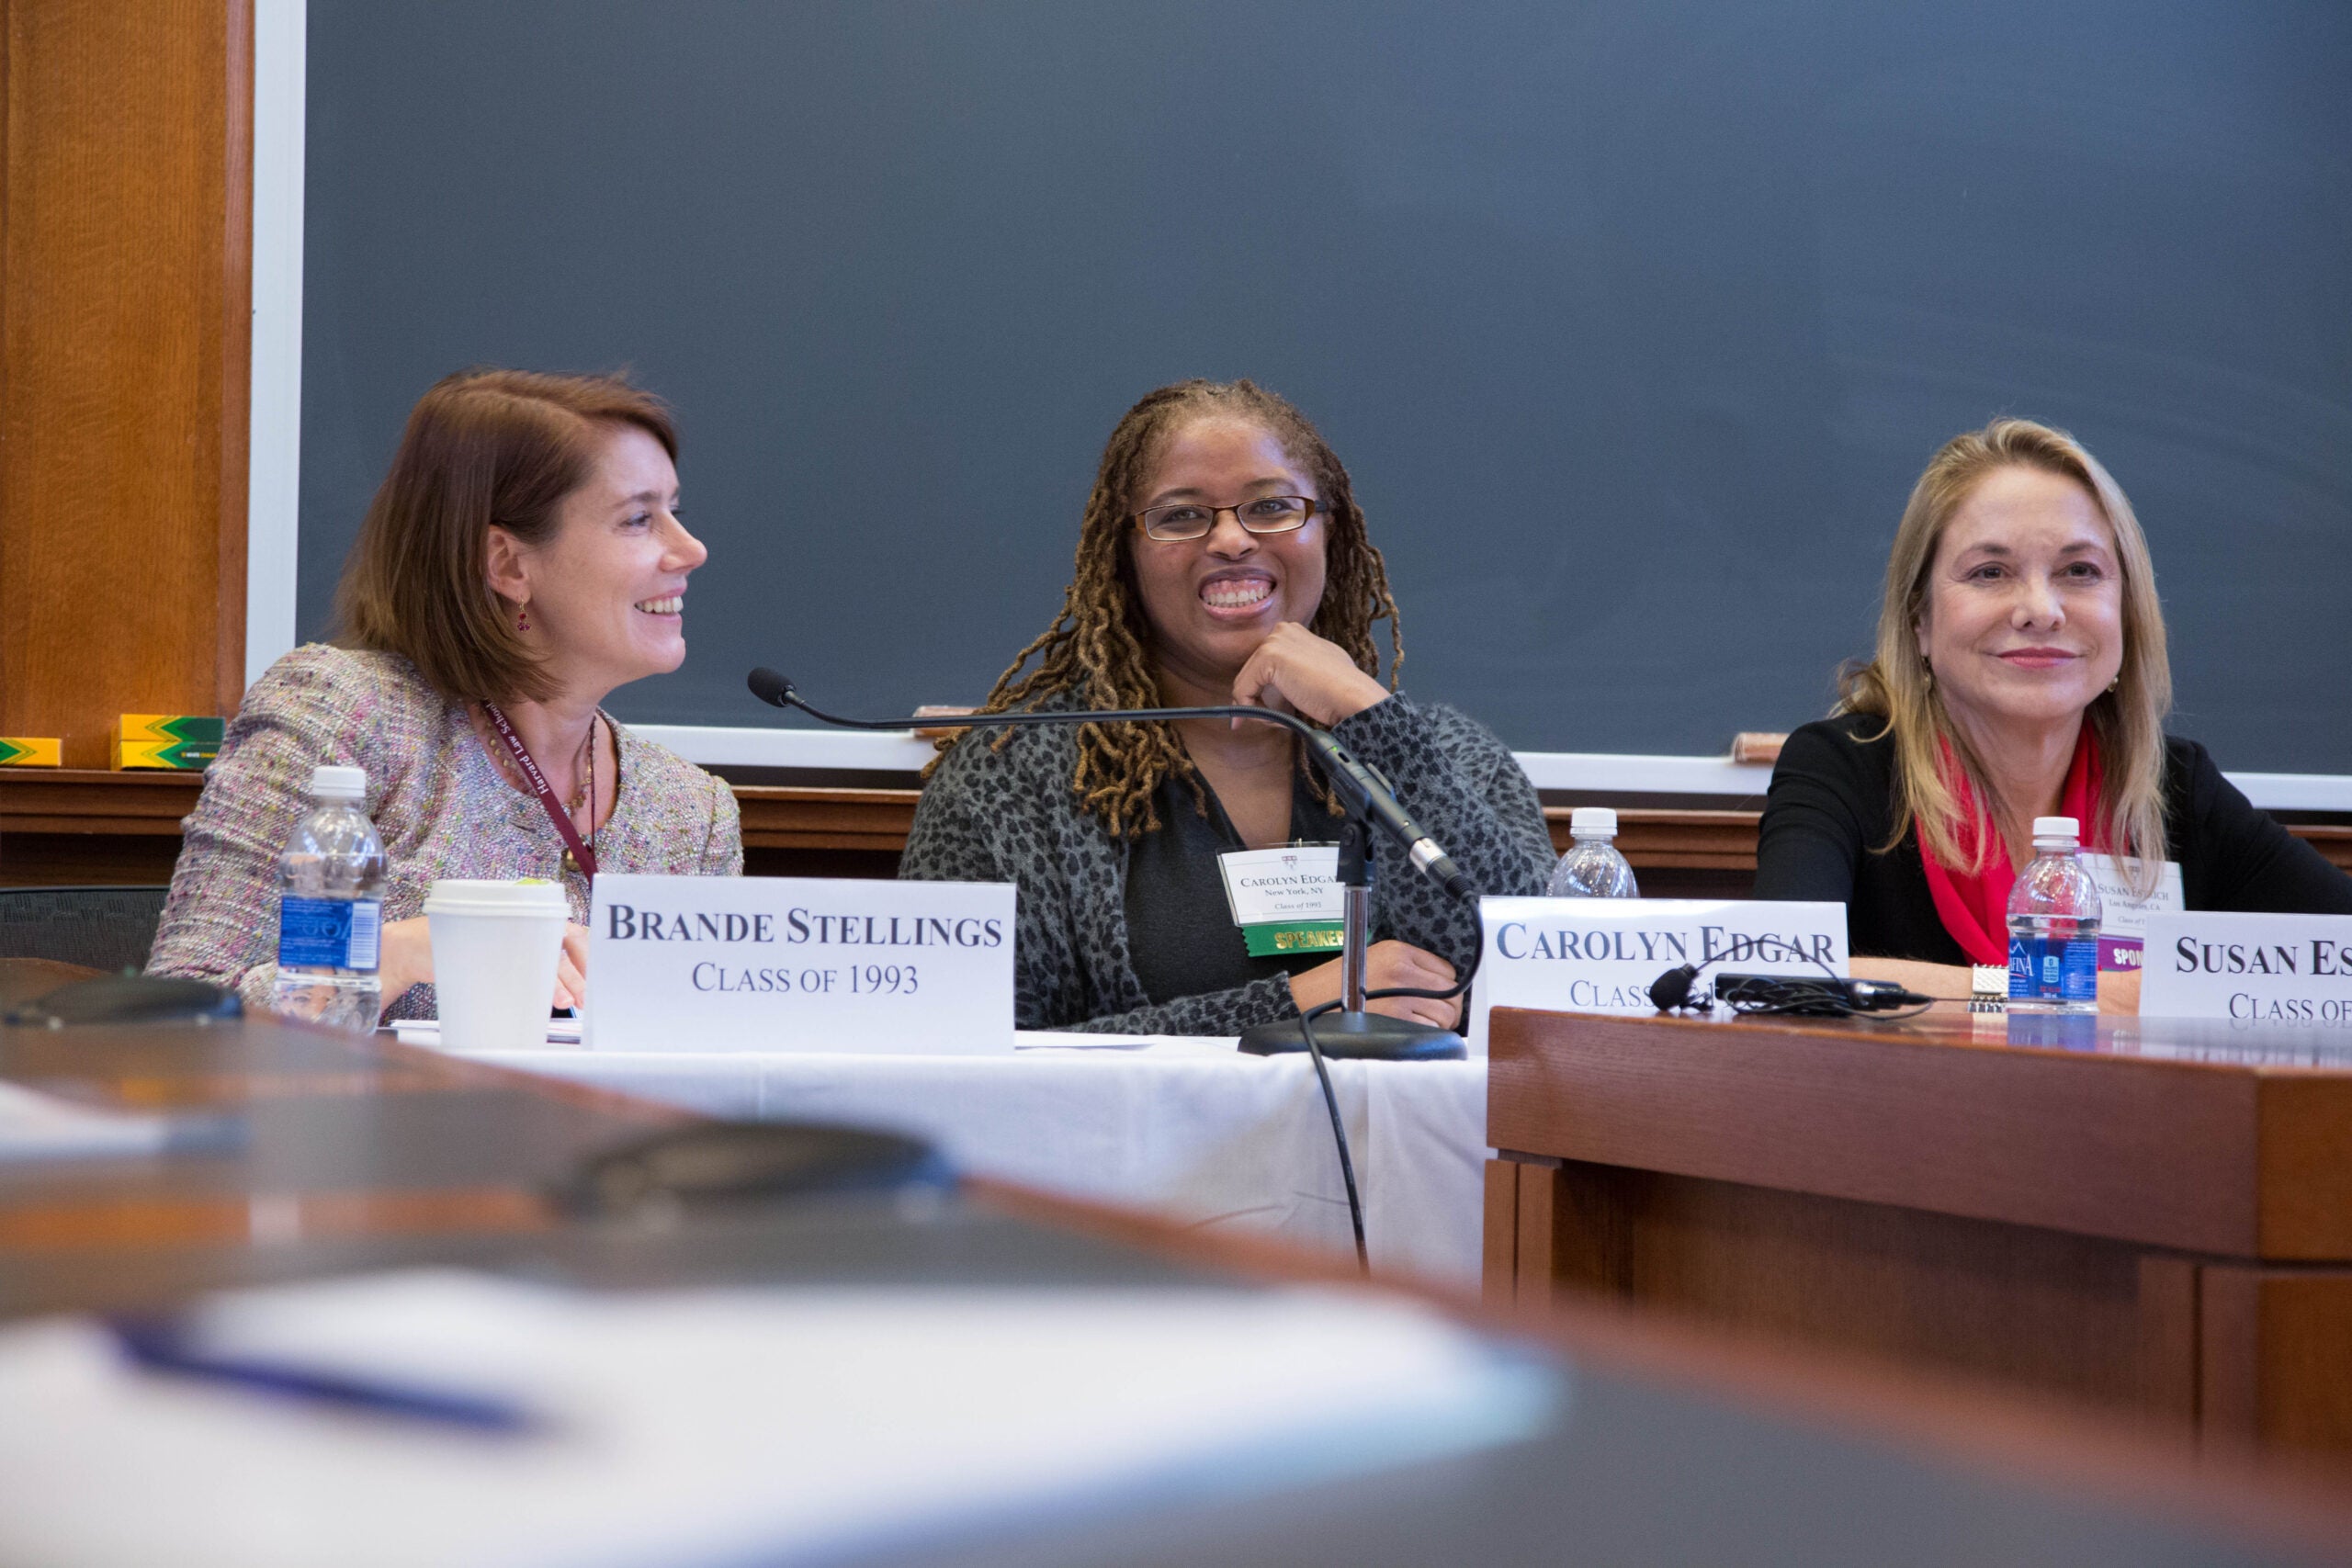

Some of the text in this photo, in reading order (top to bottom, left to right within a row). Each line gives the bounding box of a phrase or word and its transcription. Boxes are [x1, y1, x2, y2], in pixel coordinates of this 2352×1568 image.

[486, 703, 549, 795] Harvard Law School
[1240, 874, 1338, 887] CAROLYN EDGA
[1286, 887, 1308, 897] York,
[2098, 884, 2130, 897] SUSAN
[606, 904, 1002, 948] BRANDE STELLINGS
[1496, 922, 1837, 964] CAROLYN EDGAR
[2176, 936, 2300, 976] SUSAN
[692, 962, 919, 995] CLASS OF 1993
[1569, 979, 1655, 1008] CLASS
[2229, 992, 2313, 1021] CLASS
